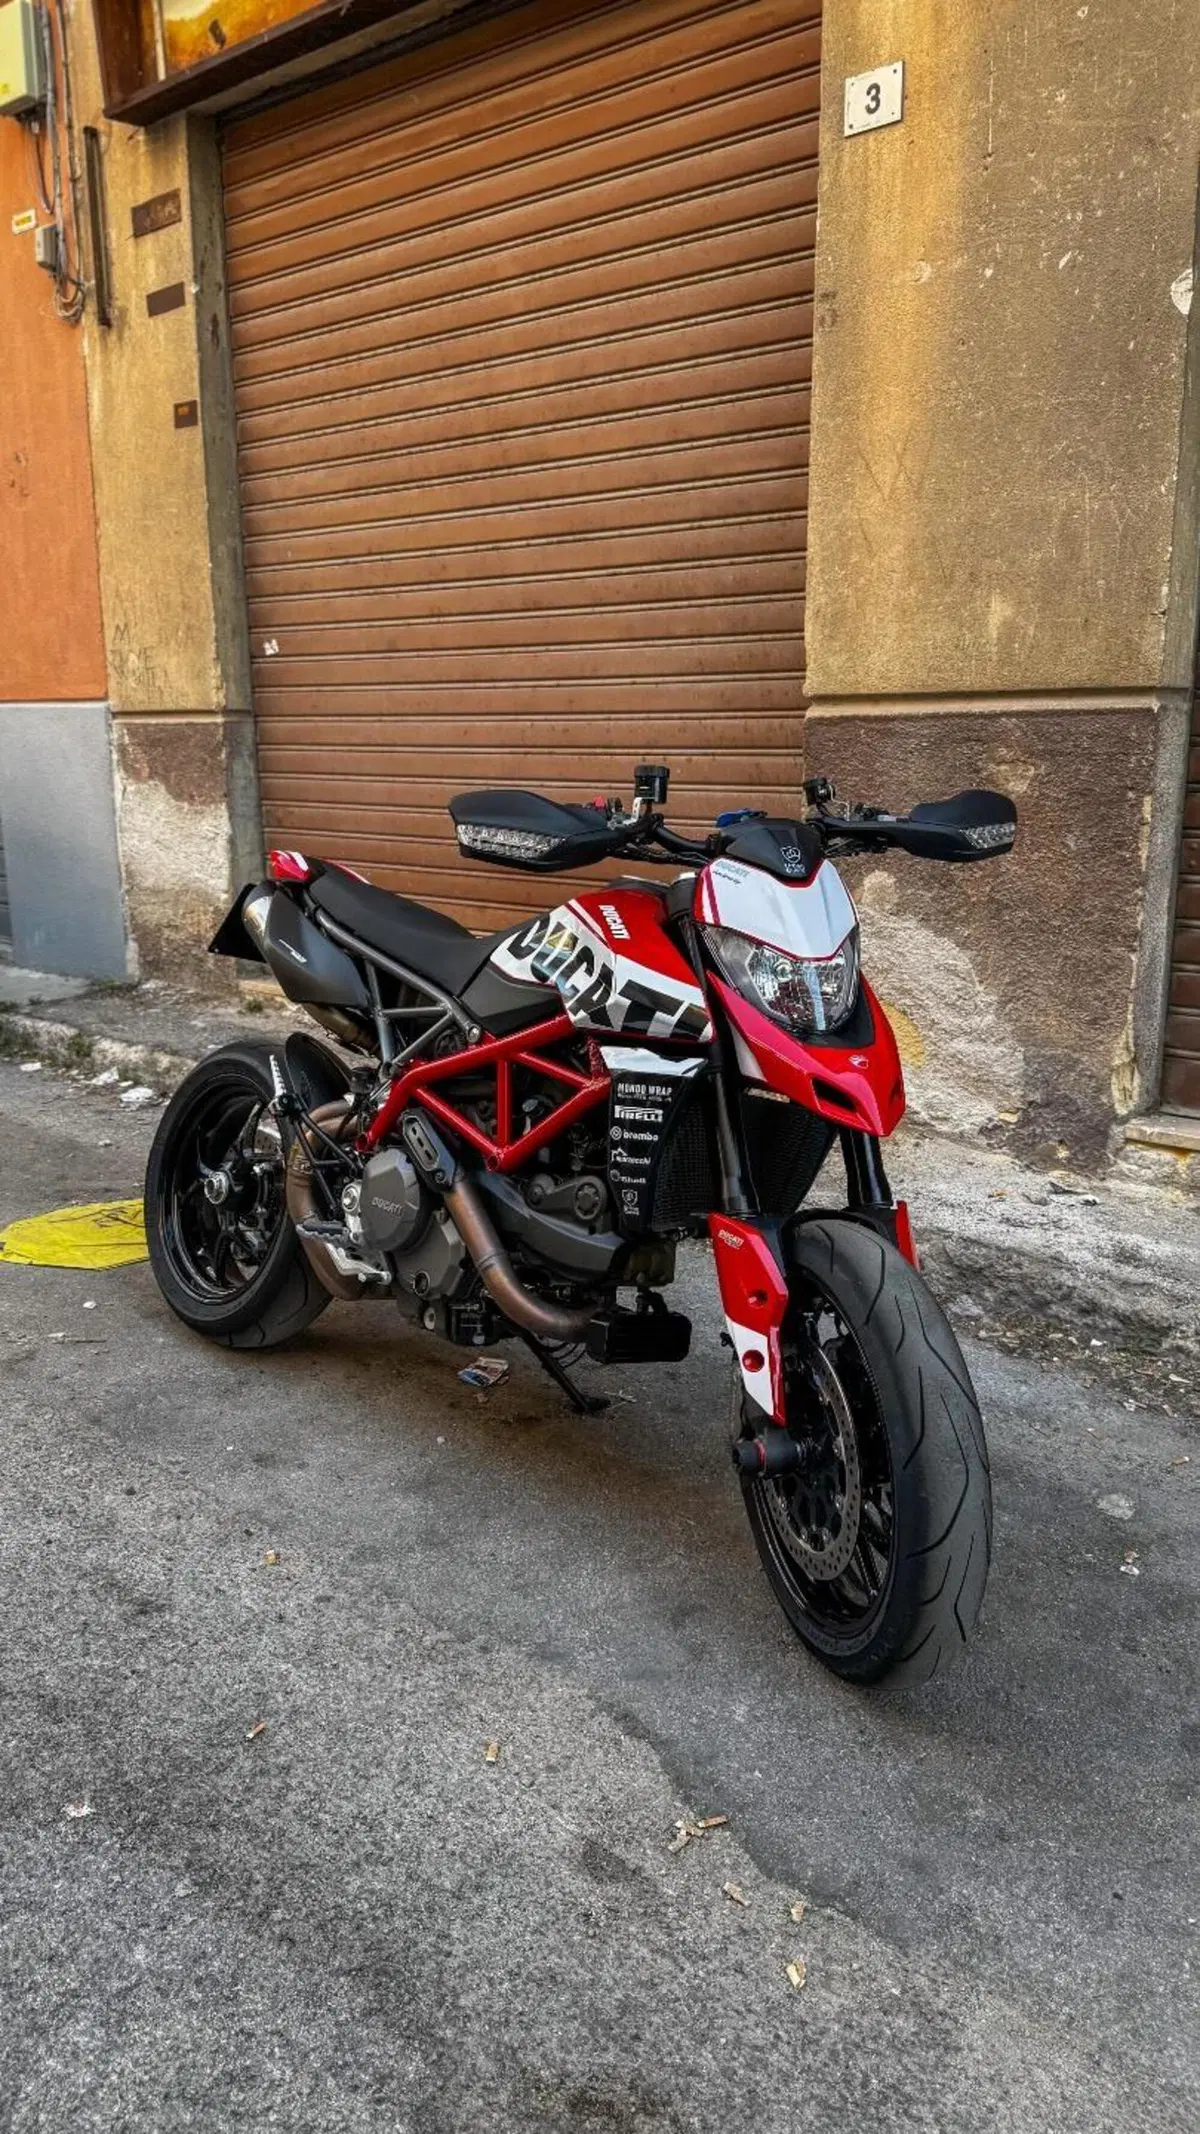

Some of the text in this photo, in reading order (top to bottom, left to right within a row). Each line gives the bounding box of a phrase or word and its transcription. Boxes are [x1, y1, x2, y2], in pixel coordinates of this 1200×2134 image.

[864, 82, 881, 115] 3
[598, 904, 631, 940] DUCATI
[507, 912, 711, 1037] DUCATI
[617, 1082, 673, 1097] MONDO WRAP
[614, 1104, 664, 1123] PIRELLI
[622, 1129, 659, 1142] brembo
[371, 1196, 403, 1215] DUCATI
[717, 1228, 745, 1247] DUCATI
